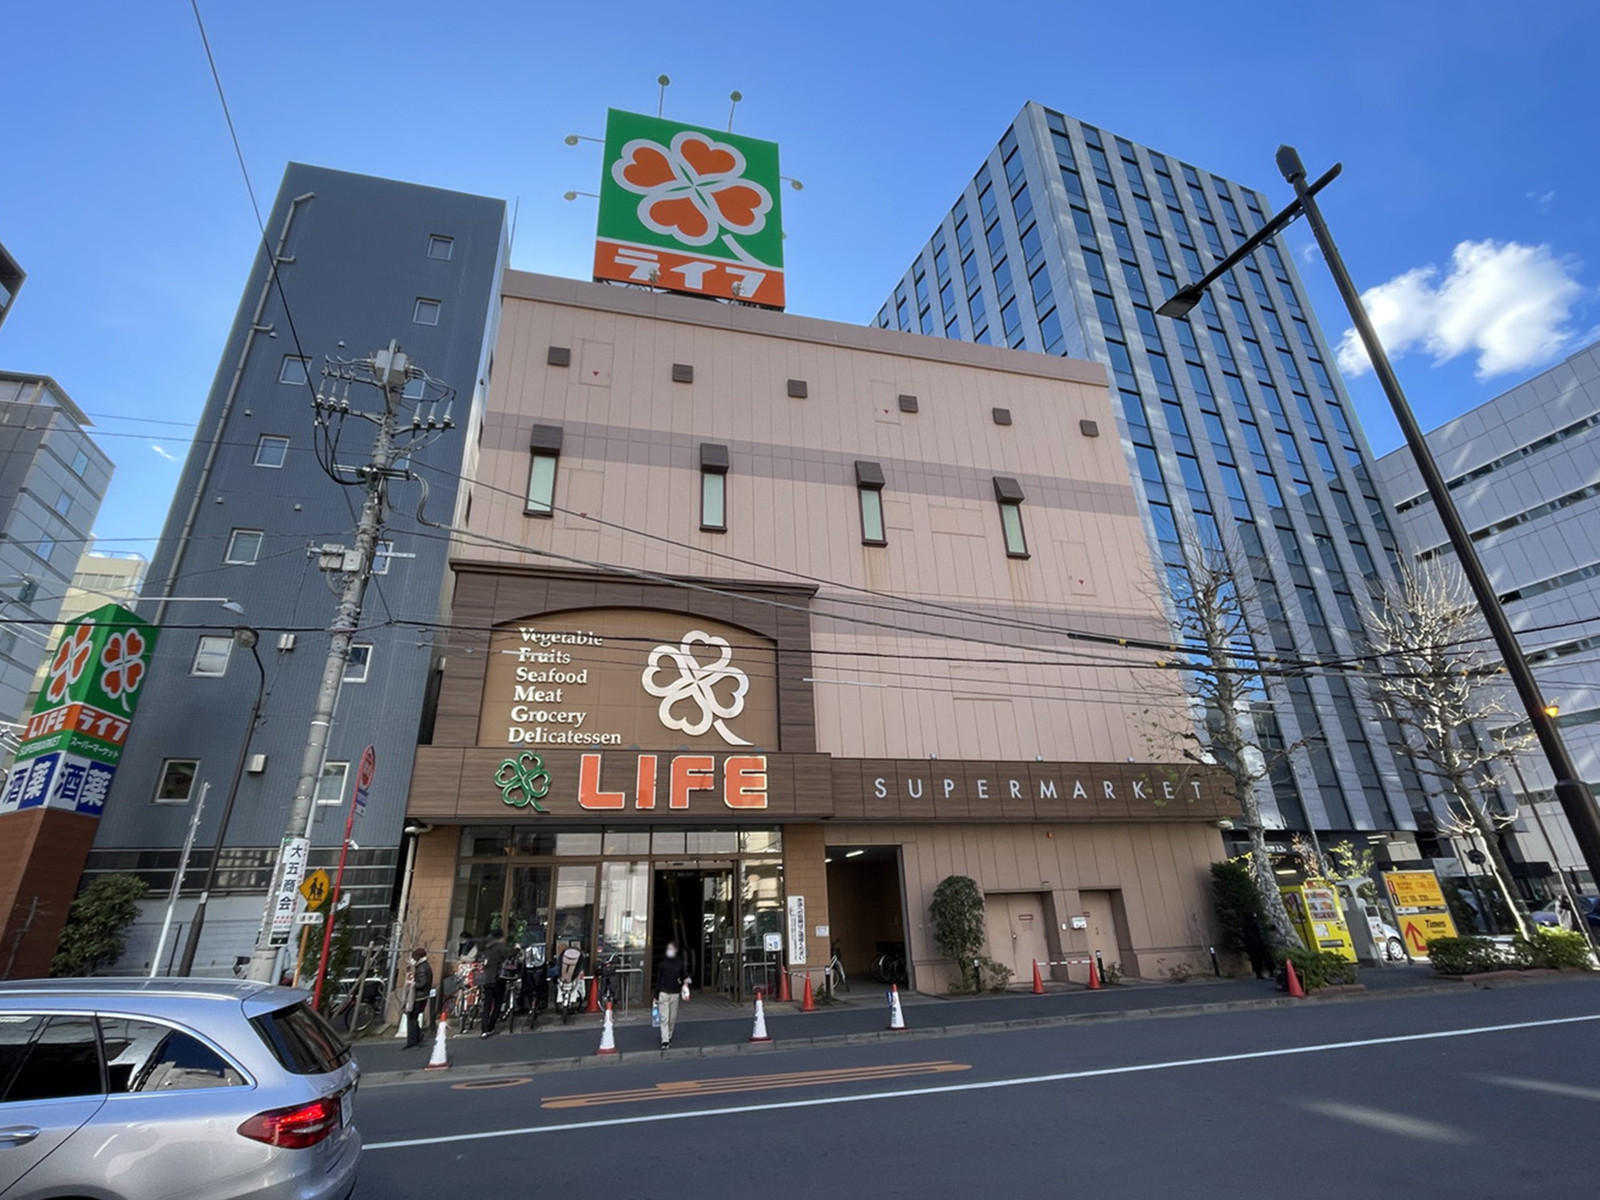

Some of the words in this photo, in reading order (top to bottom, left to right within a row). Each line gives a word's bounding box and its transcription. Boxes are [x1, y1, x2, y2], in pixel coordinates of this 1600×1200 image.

[614, 248, 766, 298] ライフ
[519, 627, 604, 647] Vegetable
[518, 647, 571, 664] Fruits
[516, 666, 588, 684] Seafood
[513, 685, 563, 702] Meat
[28, 707, 69, 739] LIFE
[79, 708, 128, 741] ライフ
[511, 705, 587, 728] Grocery
[508, 727, 622, 744] Delicatessen
[70, 736, 119, 759] スーパーマーケット
[578, 754, 768, 809] LIFE
[874, 778, 1203, 800] SUPERMARKET
[278, 844, 303, 911] 大五商会
